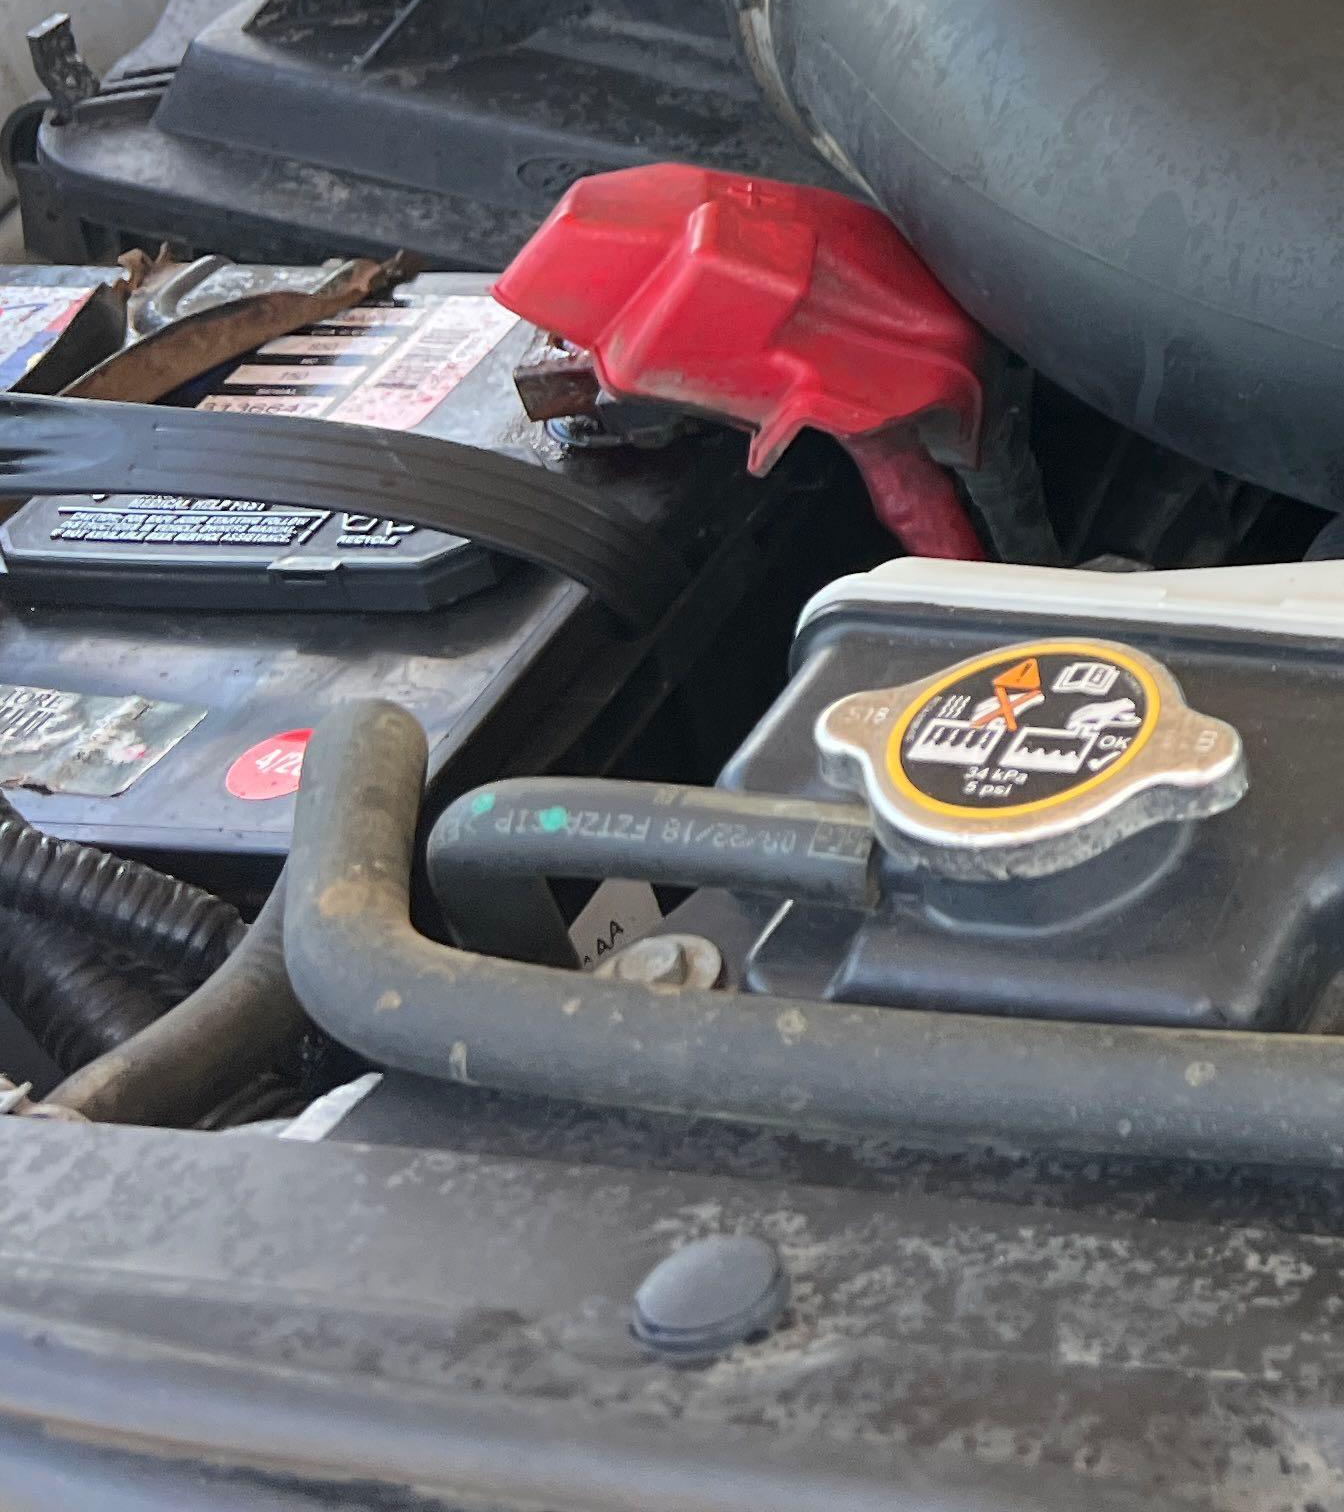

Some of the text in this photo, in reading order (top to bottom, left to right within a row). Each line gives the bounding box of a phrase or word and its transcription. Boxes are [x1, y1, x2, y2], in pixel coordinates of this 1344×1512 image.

[1099, 735, 1131, 749] OK
[963, 767, 1029, 785] 34 kPa
[979, 783, 1013, 798] psi
